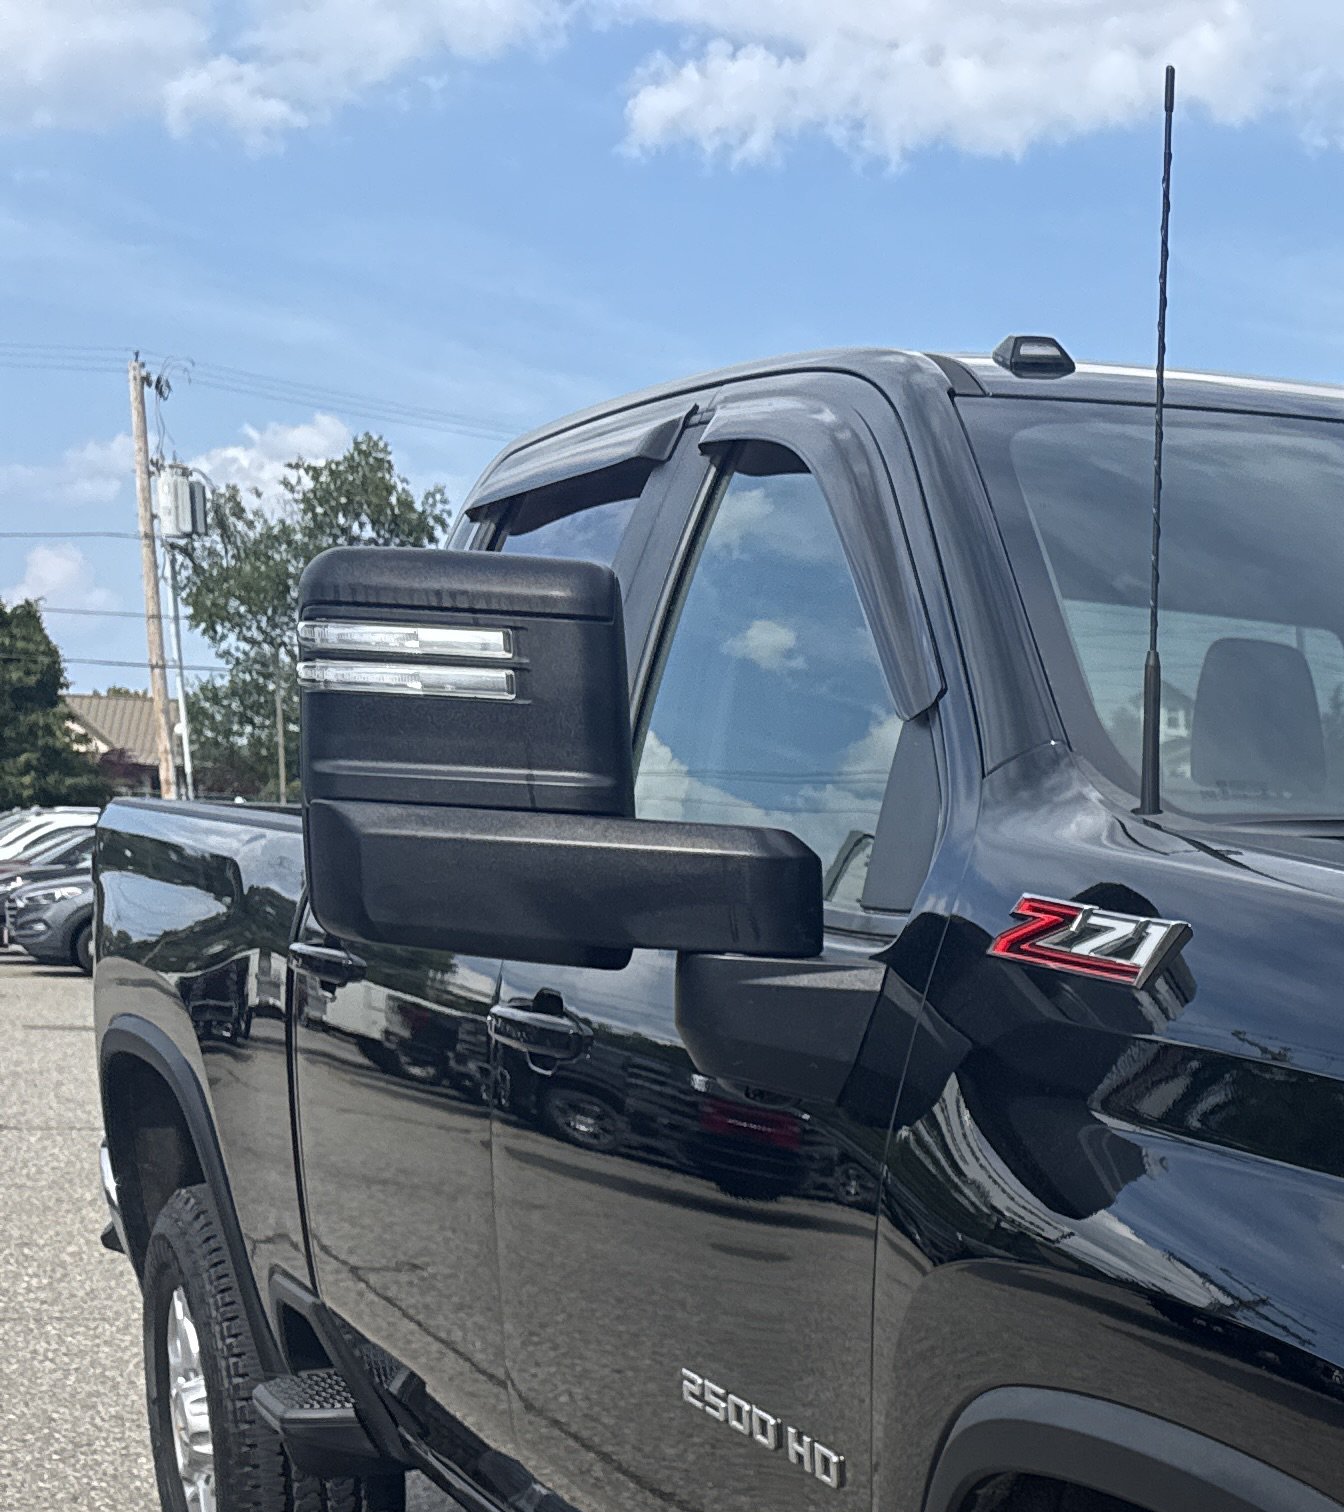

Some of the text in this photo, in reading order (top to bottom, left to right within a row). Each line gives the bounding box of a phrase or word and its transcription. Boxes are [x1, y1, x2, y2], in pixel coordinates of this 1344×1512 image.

[986, 892, 1193, 990] Z71
[682, 1367, 845, 1489] 2500 HD
